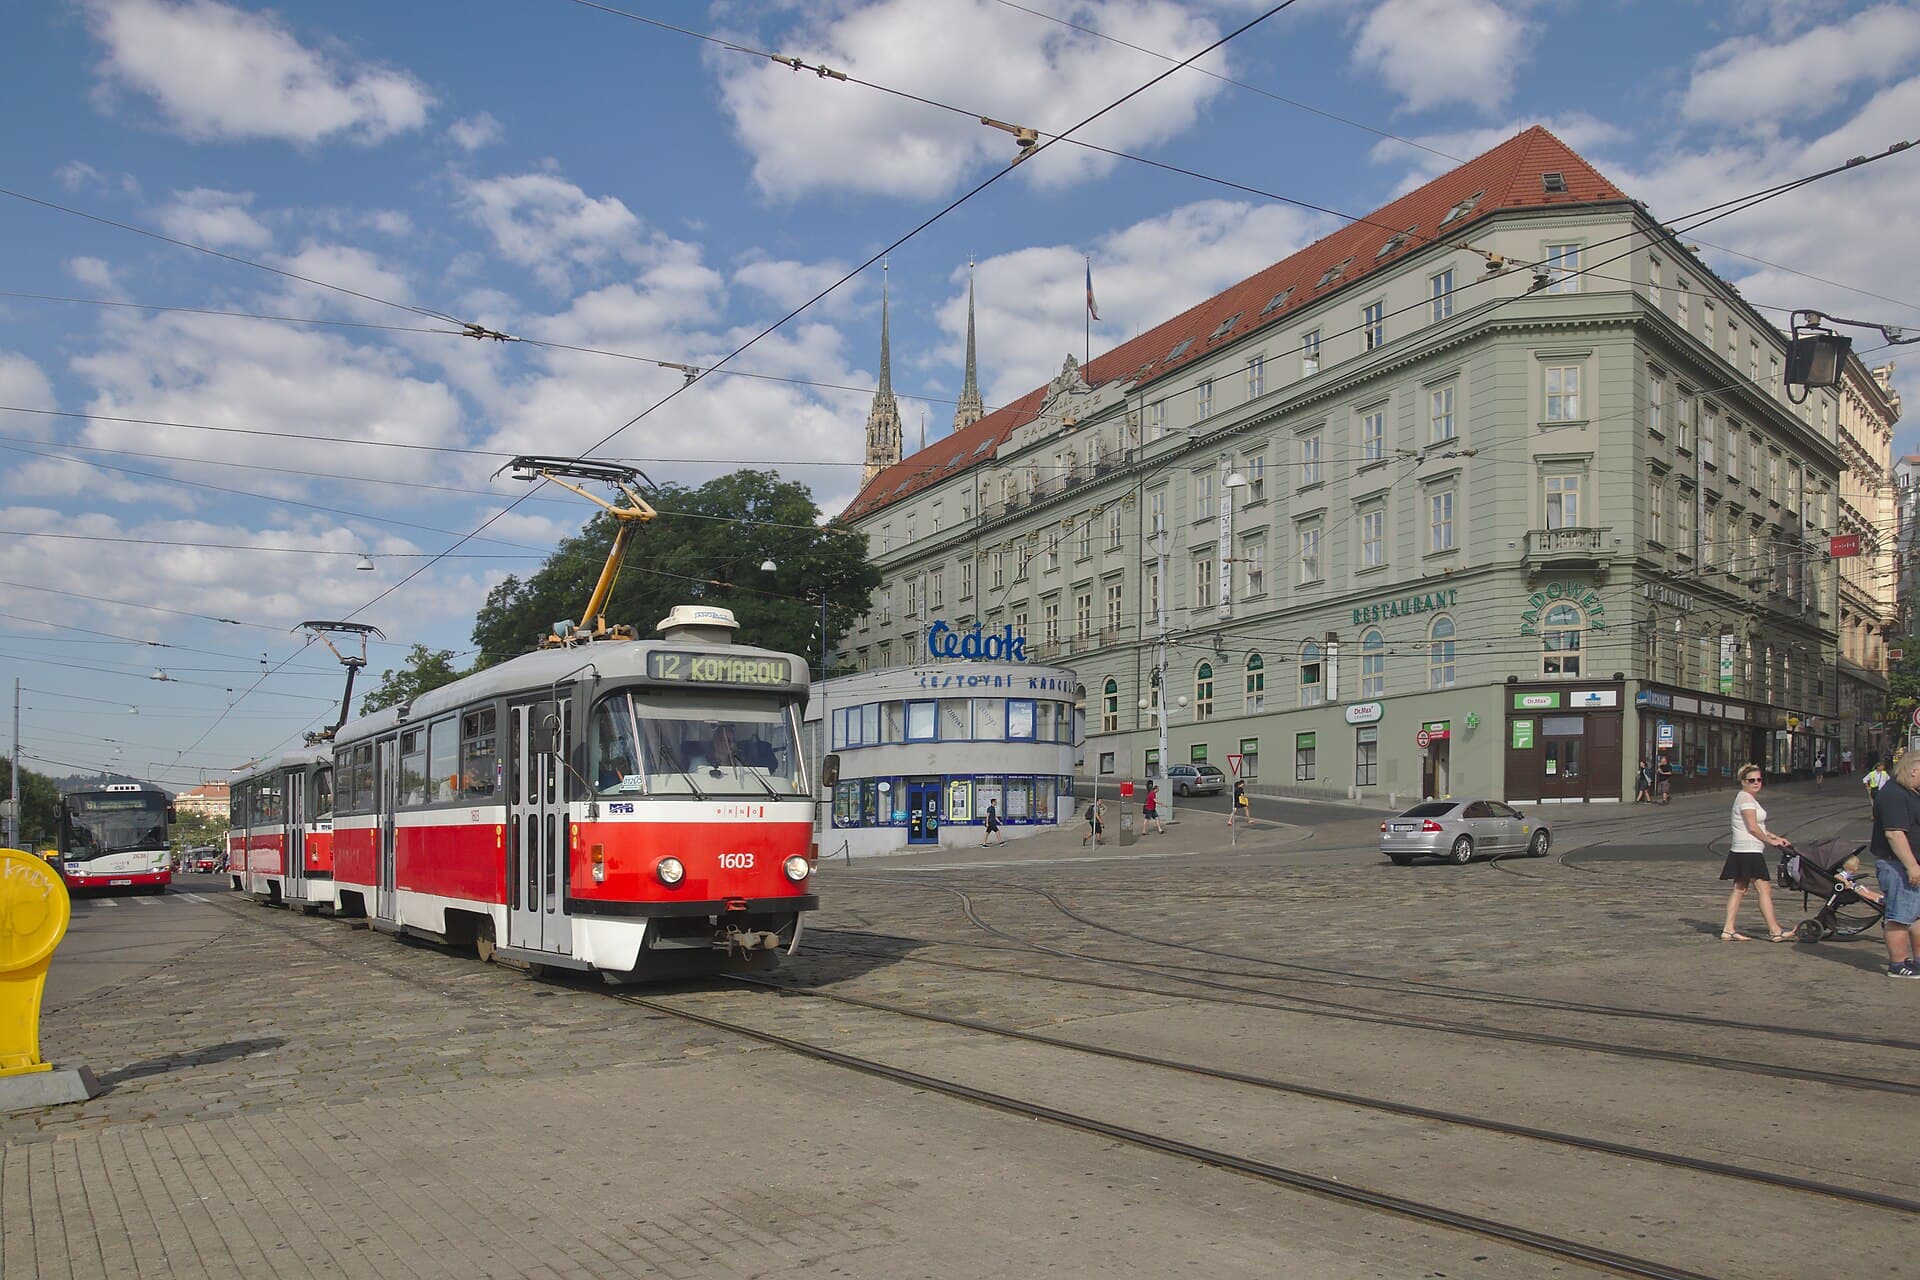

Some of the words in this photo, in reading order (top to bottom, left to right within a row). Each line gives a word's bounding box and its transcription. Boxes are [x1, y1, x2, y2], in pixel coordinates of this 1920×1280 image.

[1352, 588, 1458, 625] RESTAURANT
[1520, 580, 1606, 637] PADOWETZ
[928, 619, 1028, 661] Čedok
[655, 653, 680, 679] 12
[691, 656, 784, 684] KOMAROV
[717, 852, 755, 870] 1603
